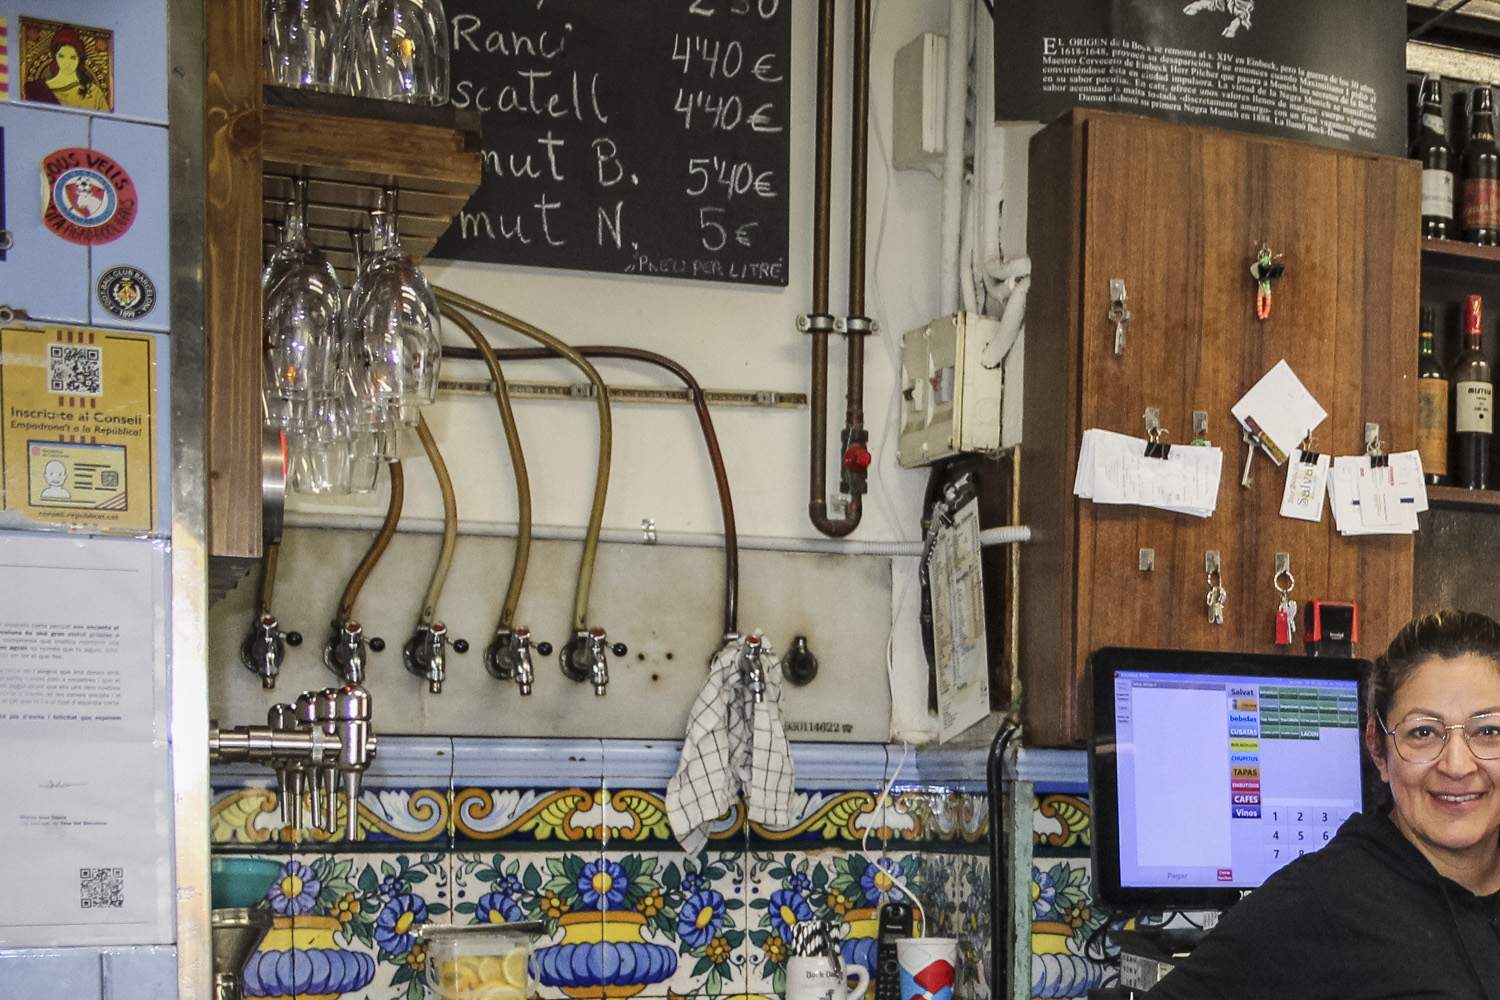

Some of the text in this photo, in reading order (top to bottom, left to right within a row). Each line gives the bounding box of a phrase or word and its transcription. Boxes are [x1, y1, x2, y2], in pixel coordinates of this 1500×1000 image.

[451, 15, 573, 58] Ranci
[1069, 38, 1108, 47] ORIGEN
[1122, 39, 1130, 48] la
[1164, 47, 1196, 57] remonta
[1198, 50, 1206, 58] al
[1217, 52, 1234, 62] XIV
[1235, 57, 1245, 65] en
[1111, 48, 1145, 60] provocó
[1148, 53, 1157, 61] su
[1216, 61, 1232, 72] Fue
[1234, 66, 1268, 78] entonces
[1042, 56, 1078, 65] Maestro
[1079, 56, 1122, 66] Cervecero
[1123, 58, 1134, 68] de
[1169, 64, 1189, 75] Herr
[1220, 73, 1235, 82] que
[1236, 75, 1261, 86] pasara
[1269, 79, 1298, 92] Munich
[1042, 66, 1107, 74] convirtiéndose
[1128, 70, 1139, 78] en
[1217, 79, 1228, 90] La
[1231, 84, 1255, 94] virtud
[1257, 86, 1267, 96] de
[1269, 87, 1277, 97] la
[451, 69, 608, 124] scatell
[1042, 83, 1066, 92] sabor
[1069, 84, 1113, 93] acentuado
[1122, 87, 1145, 97] malta
[1069, 75, 1093, 83] sabor
[1199, 88, 1218, 98] unos
[1220, 91, 1250, 102] valores
[1252, 94, 1276, 106] llenos
[1078, 93, 1106, 102] Damm
[1150, 100, 1183, 112] primera
[1183, 103, 1208, 115] Negra
[1209, 107, 1239, 120] Munich
[481, 131, 639, 187] mut B.
[459, 193, 639, 250] mut N.
[1233, 767, 1258, 777] TAPAS
[1236, 808, 1257, 818] Vinos
[1273, 811, 1328, 822] 1 2 3
[1273, 831, 1329, 841] 4 5 6
[1273, 849, 1279, 859] 7
